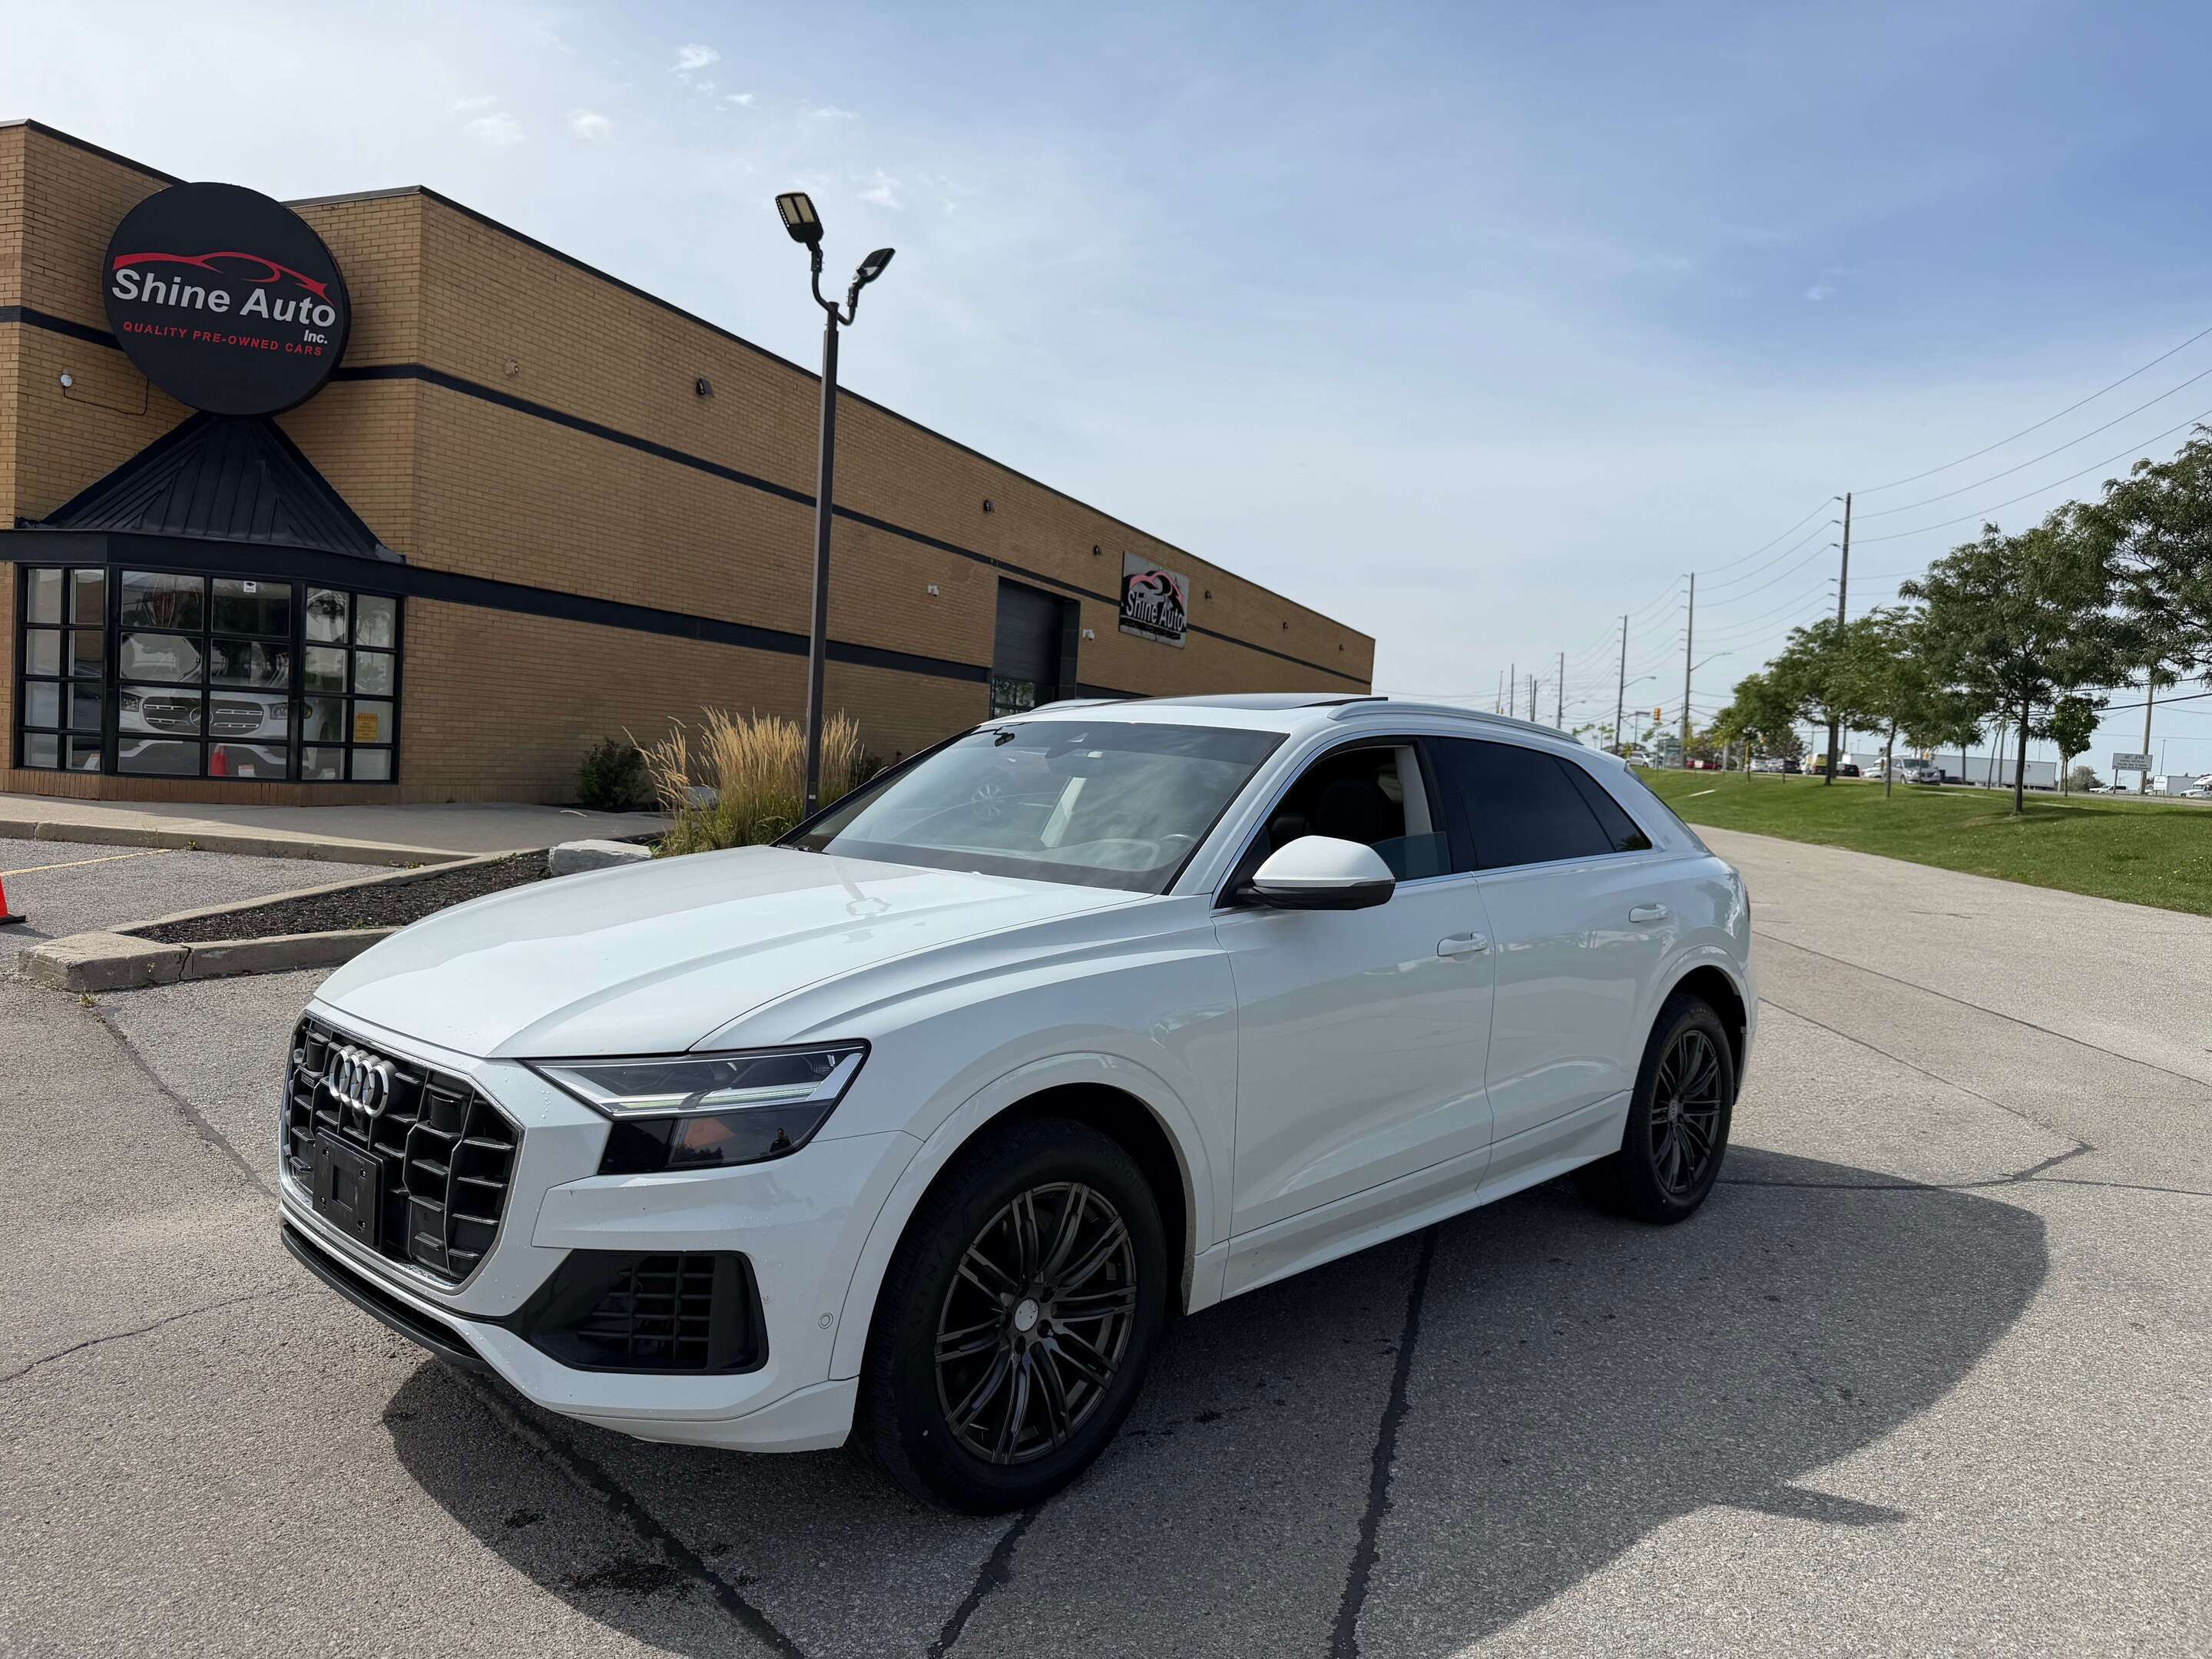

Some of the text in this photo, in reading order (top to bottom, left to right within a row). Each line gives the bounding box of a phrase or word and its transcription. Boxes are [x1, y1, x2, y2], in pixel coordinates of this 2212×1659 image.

[112, 269, 336, 327] Shine Auto
[123, 321, 323, 356] QUALITY PRE-OWNED CARS
[303, 329, 328, 344] Inc.
[1126, 589, 1157, 624] Shine
[1159, 601, 1184, 631] Auto
